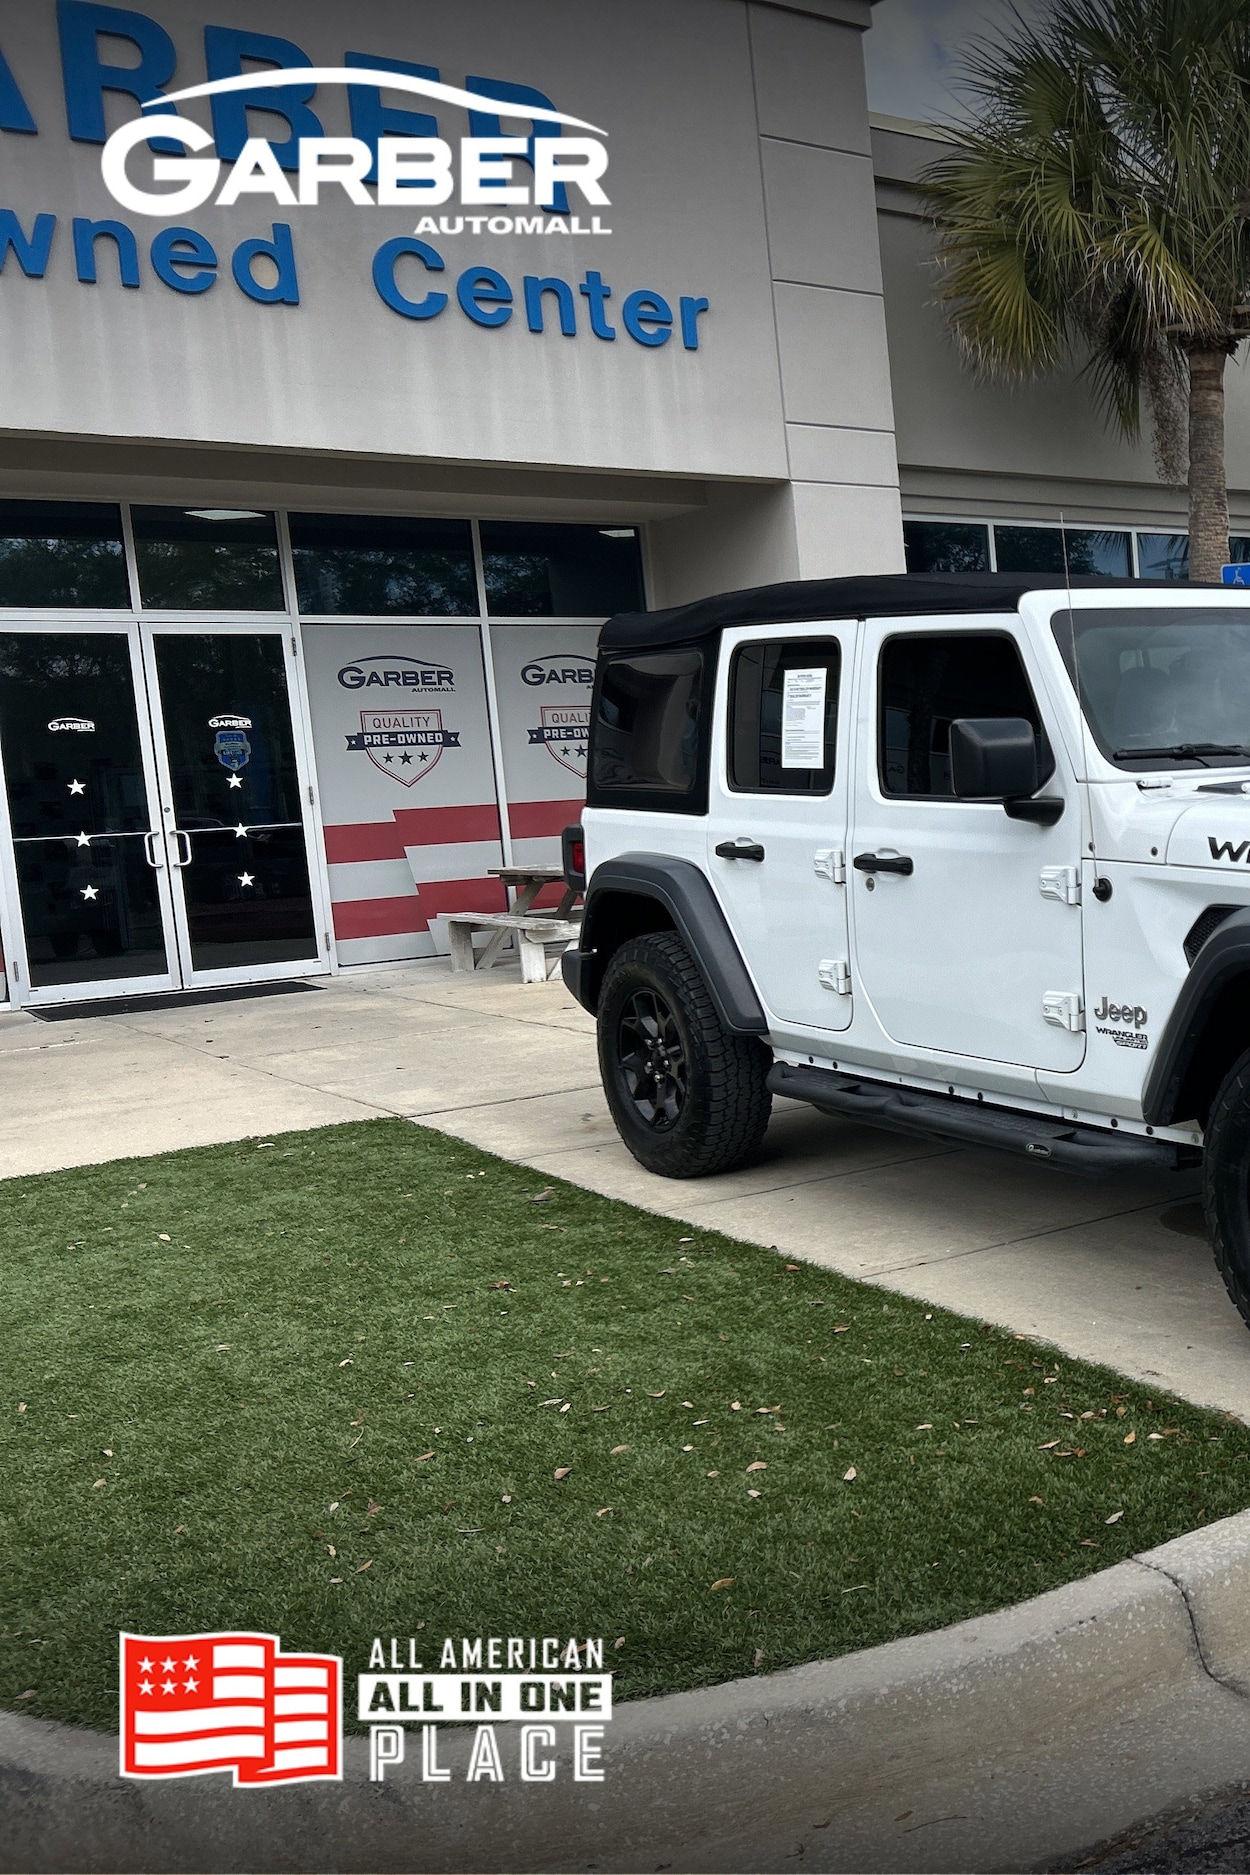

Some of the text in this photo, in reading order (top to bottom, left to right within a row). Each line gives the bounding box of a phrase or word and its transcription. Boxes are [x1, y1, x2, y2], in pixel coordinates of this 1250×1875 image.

[372, 236, 709, 350] Center
[337, 666, 455, 689] GARBER
[520, 664, 594, 686] GARB
[372, 716, 430, 729] QUALITY
[551, 712, 590, 724] QUALI
[363, 732, 444, 746] PRE-OWNED
[543, 728, 590, 739] PRE-OW
[1093, 996, 1148, 1029] Jeep
[1095, 1026, 1148, 1040] WRANGLER
